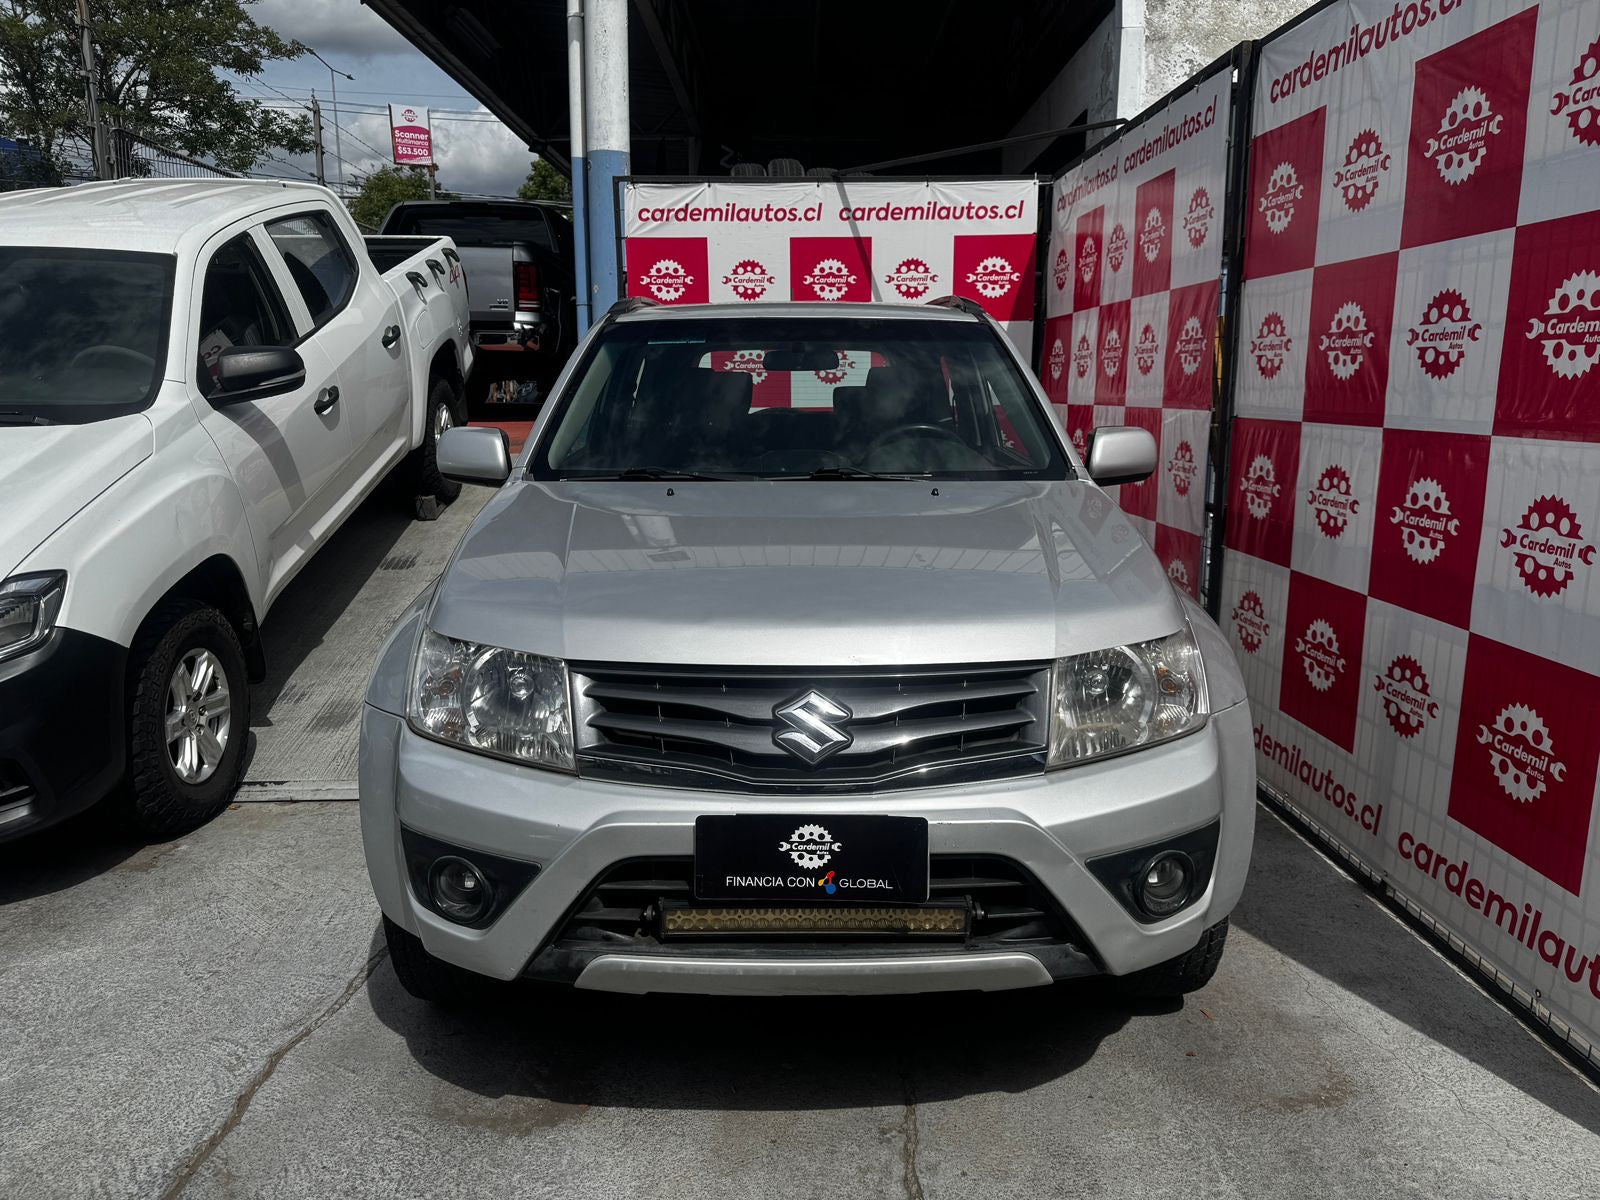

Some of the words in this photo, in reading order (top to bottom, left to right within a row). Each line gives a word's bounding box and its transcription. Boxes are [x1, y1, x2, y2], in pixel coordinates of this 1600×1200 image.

[1270, 0, 1461, 104] cardemilautos.
[394, 130, 429, 140] Scanner
[395, 138, 429, 146] Multimarca
[1123, 95, 1218, 174] cardemilautos.cl
[1440, 121, 1487, 150] Cardemil
[397, 146, 429, 156] $53.500
[1468, 140, 1485, 150] Autos
[1344, 158, 1380, 181] Cardemil
[1267, 188, 1295, 207] Cardemil
[638, 202, 823, 222] cardemilautos.cl
[838, 200, 1025, 221] cardemilautos.cl
[651, 276, 684, 284] Cardemil
[733, 276, 766, 284] Cardemil
[814, 275, 847, 283] Cardemil
[977, 273, 1010, 281] Cardemil
[1547, 316, 1600, 334] Cardem
[1330, 333, 1363, 347] Cardemil
[1421, 326, 1465, 342] Cardemil
[1258, 340, 1283, 351] Cardemil
[1448, 342, 1463, 350] Autos
[1317, 494, 1348, 510] Cardemil
[1404, 511, 1446, 531] Cardemil
[1519, 534, 1576, 559] Cardemil
[1553, 558, 1572, 569] Autos
[1306, 644, 1336, 666] Cardemil
[1386, 683, 1426, 710] Cardemil
[1494, 735, 1548, 772] Cardemil
[1253, 723, 1383, 836] demilautos.cl
[1525, 765, 1545, 781] Autos
[792, 842, 830, 851] Cardemil
[726, 876, 784, 888] FINANCIA
[787, 876, 815, 888] CON
[839, 878, 893, 889] GLOBAL
[1398, 832, 1600, 1000] cardemilaut
